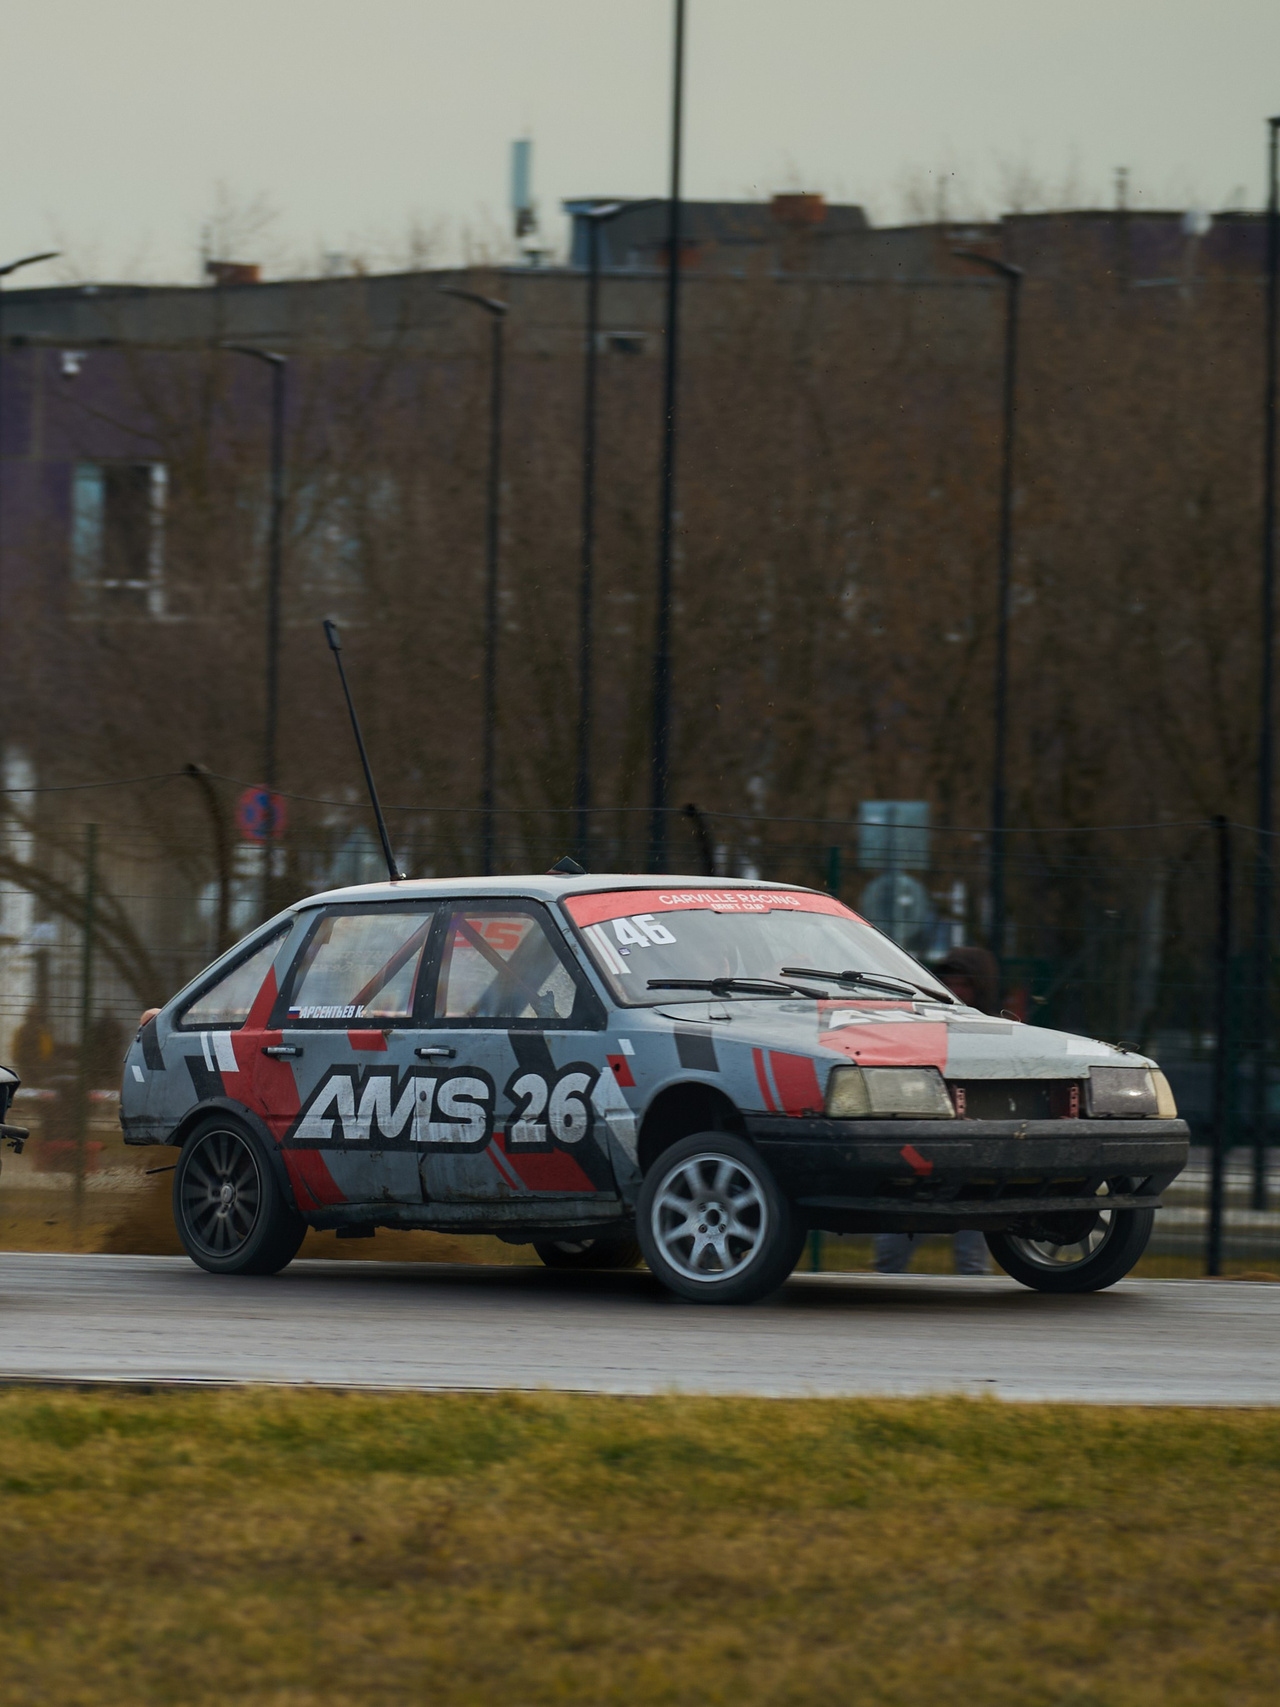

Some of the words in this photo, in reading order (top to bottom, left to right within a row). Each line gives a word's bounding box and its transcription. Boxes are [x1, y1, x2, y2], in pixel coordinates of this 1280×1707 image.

[658, 893, 738, 906] CARVILLE
[738, 893, 800, 907] RACING
[611, 914, 677, 948] 46
[298, 1005, 354, 1018] АРСЕНТЬЕВ
[292, 1075, 490, 1143] AMS
[510, 1072, 592, 1144] 26
